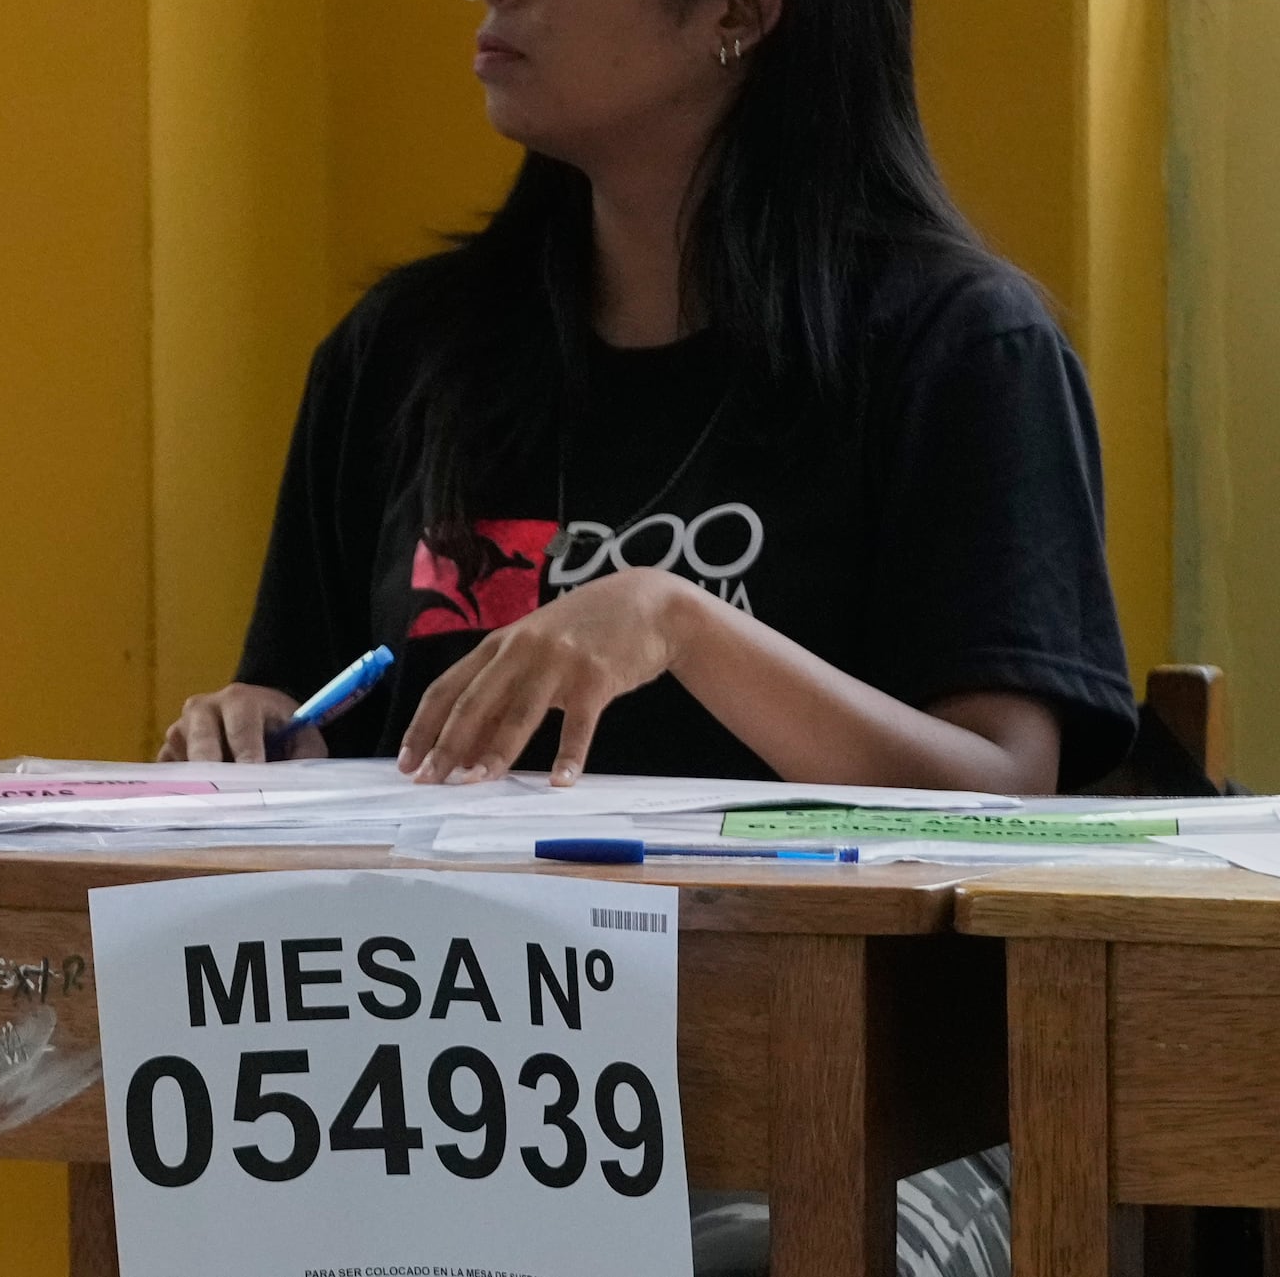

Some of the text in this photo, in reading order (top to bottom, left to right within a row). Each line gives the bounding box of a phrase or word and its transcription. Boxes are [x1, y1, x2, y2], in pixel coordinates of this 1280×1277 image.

[183, 936, 502, 1027] MESA
[125, 1043, 665, 1197] 054939
[305, 1269, 336, 1277] PARA
[338, 1267, 362, 1277] SER
[365, 1266, 431, 1276] COLOCADO
[433, 1266, 448, 1276] EN
[450, 1267, 464, 1277] LA
[466, 1268, 493, 1277] MESA
